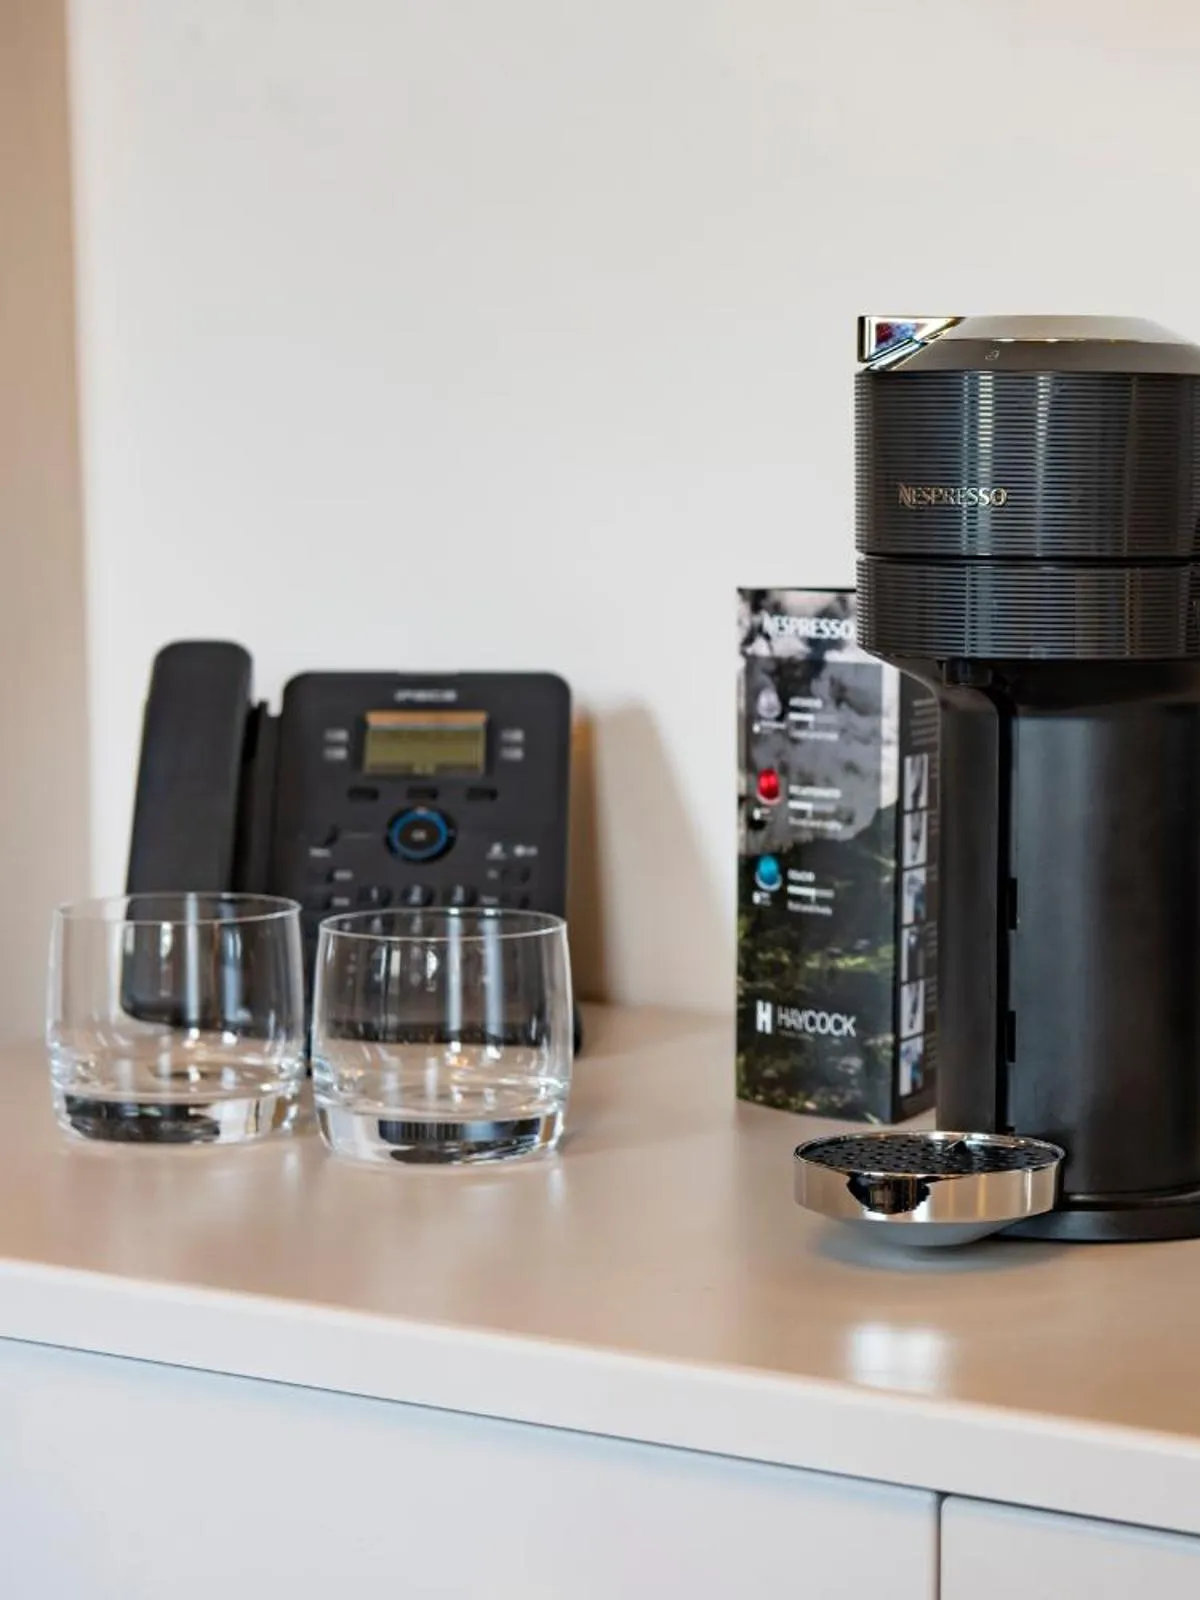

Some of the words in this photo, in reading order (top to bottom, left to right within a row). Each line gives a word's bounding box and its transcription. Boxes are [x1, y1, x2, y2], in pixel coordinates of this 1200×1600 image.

[898, 483, 1008, 509] NESPRESSO
[762, 611, 856, 640] NESPRESSO
[777, 1005, 857, 1038] HAYCOCK
